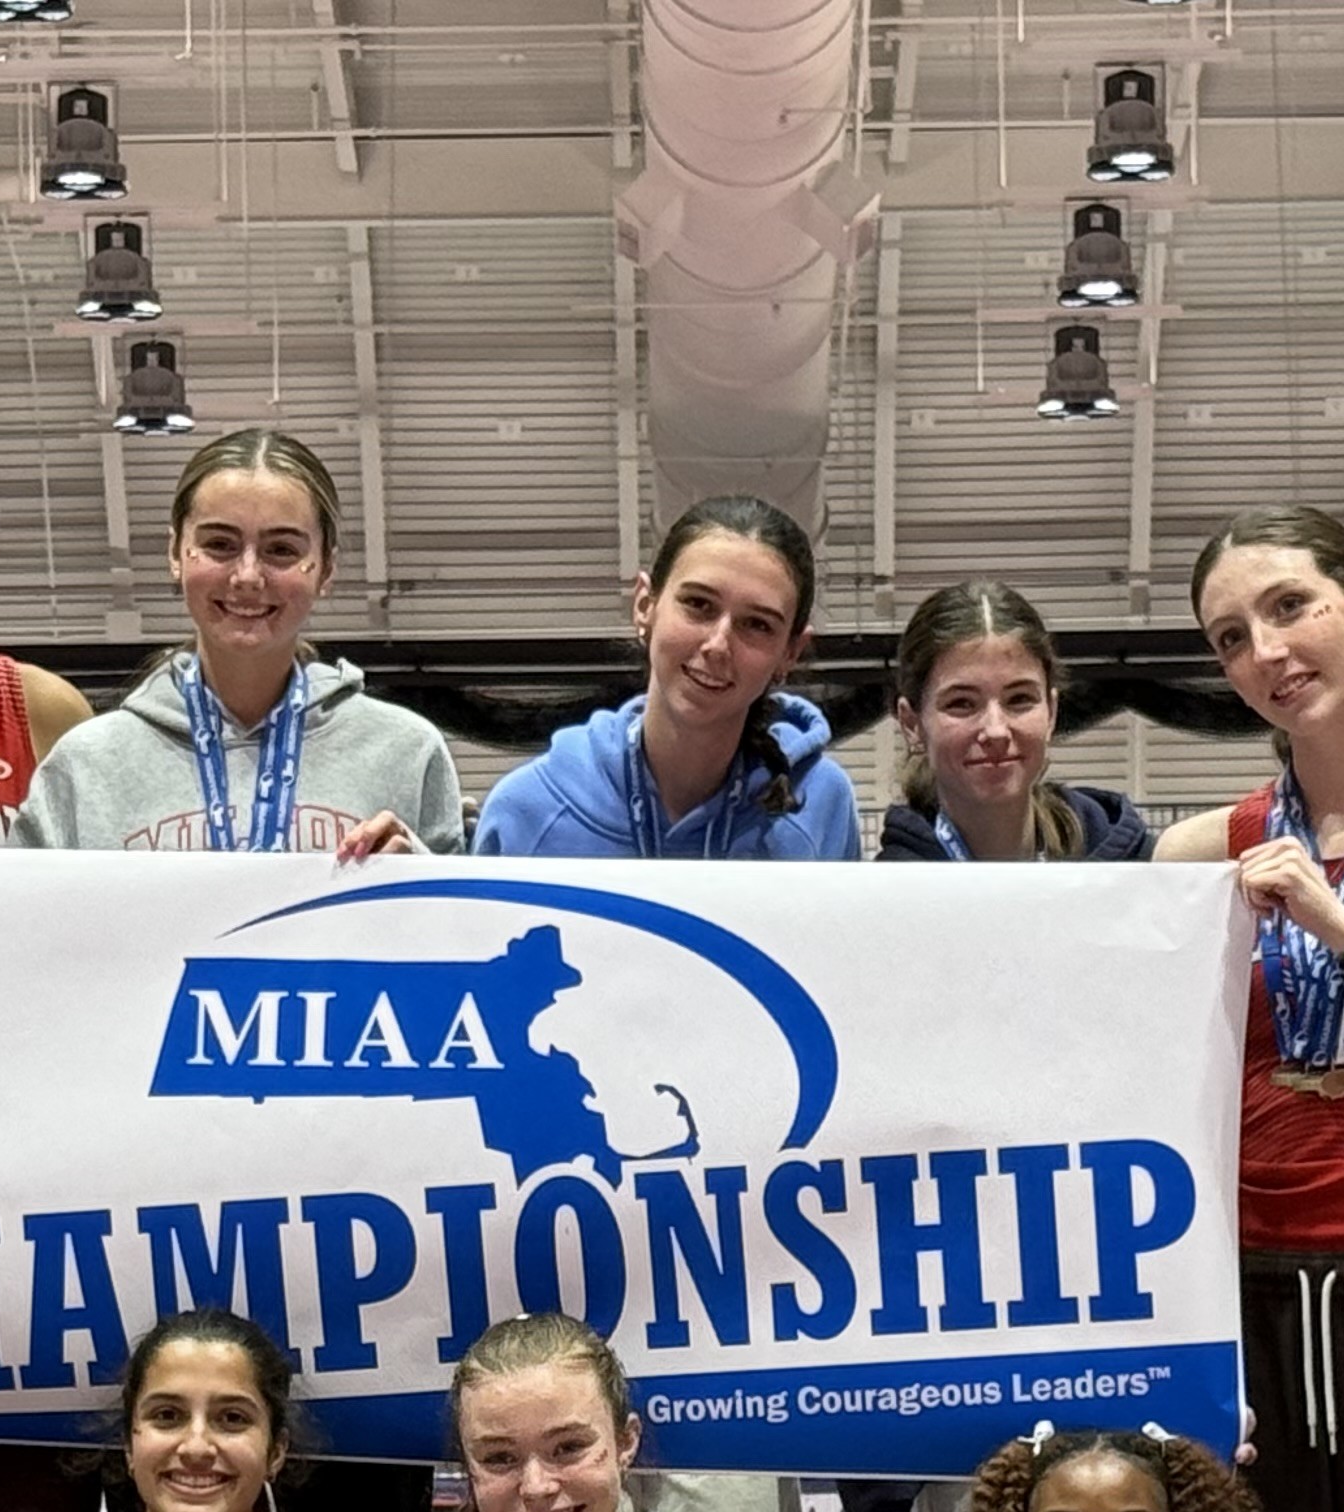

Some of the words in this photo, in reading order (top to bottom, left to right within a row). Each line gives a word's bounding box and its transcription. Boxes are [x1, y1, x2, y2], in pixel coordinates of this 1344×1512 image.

[185, 988, 506, 1070] MIAA
[647, 1388, 789, 1424] Growing
[796, 1377, 1003, 1416] Courageous
